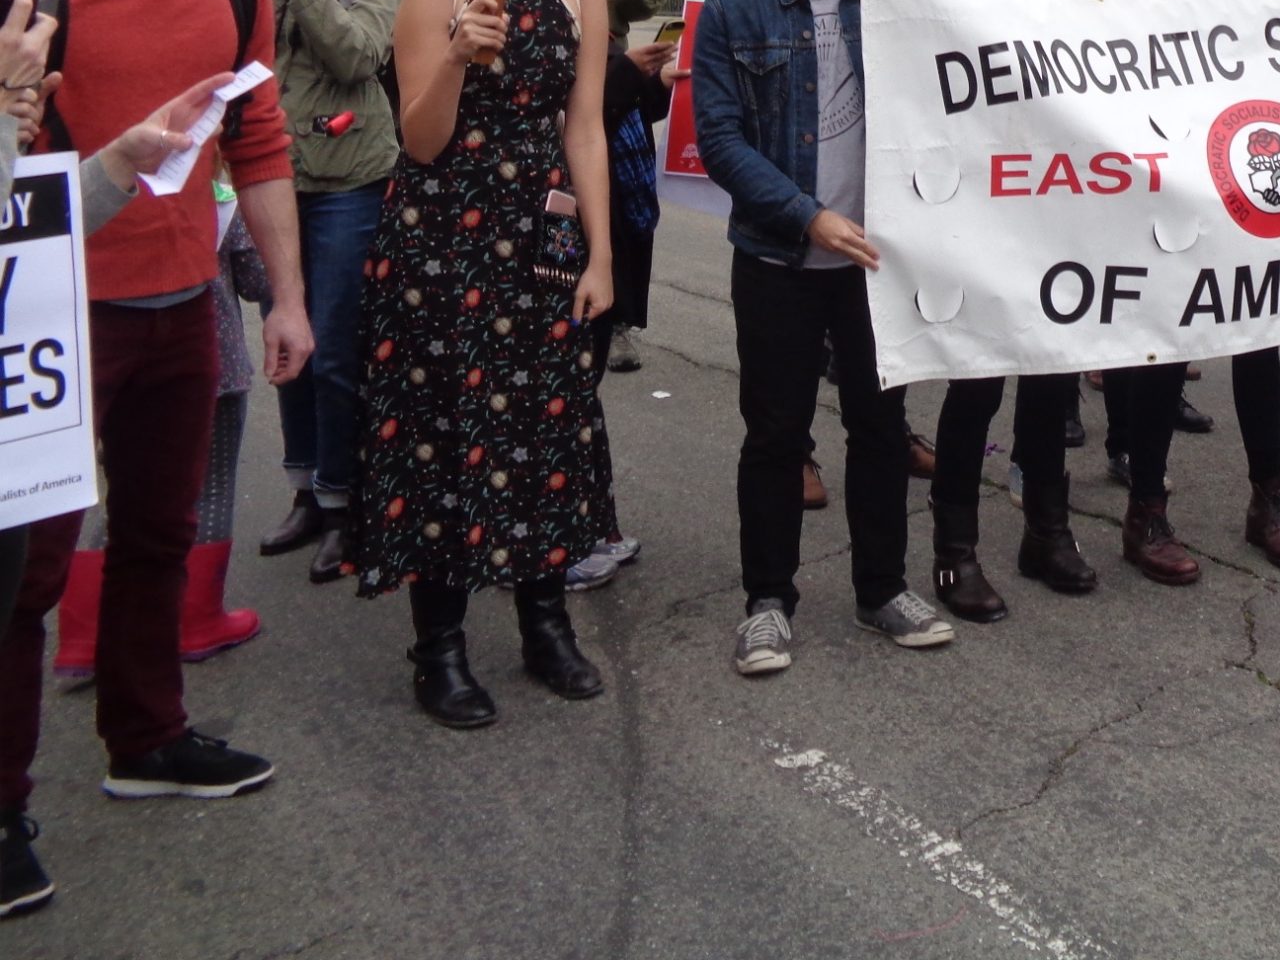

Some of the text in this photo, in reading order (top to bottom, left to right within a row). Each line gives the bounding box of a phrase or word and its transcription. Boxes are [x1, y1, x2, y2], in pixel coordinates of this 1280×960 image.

[935, 25, 1244, 115] DEMOCRATIC
[990, 152, 1168, 197] EAST
[1212, 131, 1250, 222] DEMOCRATIC
[1040, 261, 1148, 325] OF
[29, 482, 40, 494] of
[41, 474, 82, 491] America
